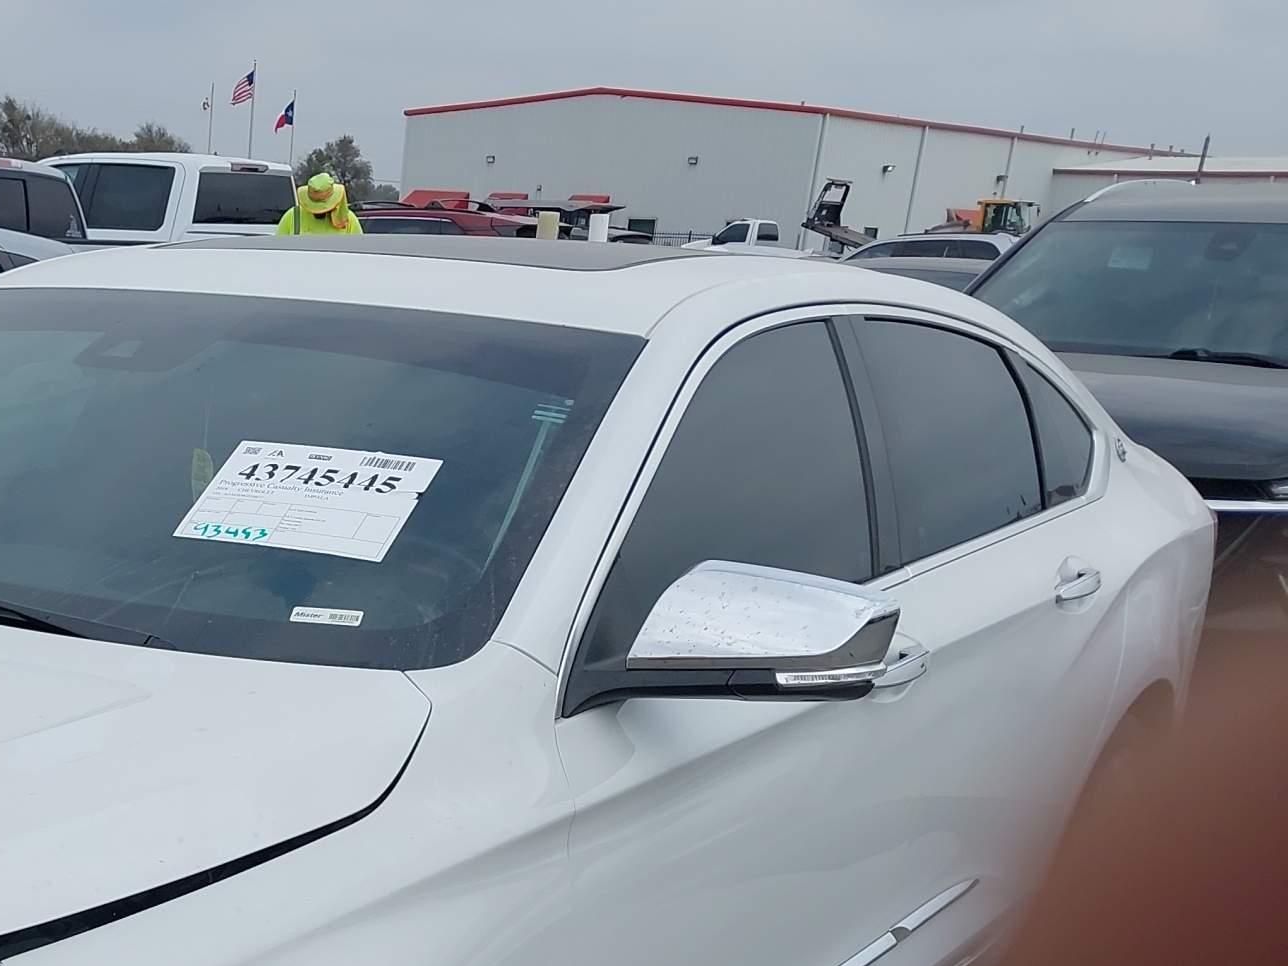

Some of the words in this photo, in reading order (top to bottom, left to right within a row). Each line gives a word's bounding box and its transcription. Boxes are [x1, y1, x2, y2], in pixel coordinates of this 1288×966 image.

[219, 479, 266, 489] Progressive
[267, 482, 302, 493] Casualty
[304, 486, 344, 497] Insurance
[238, 462, 402, 494] 43745445
